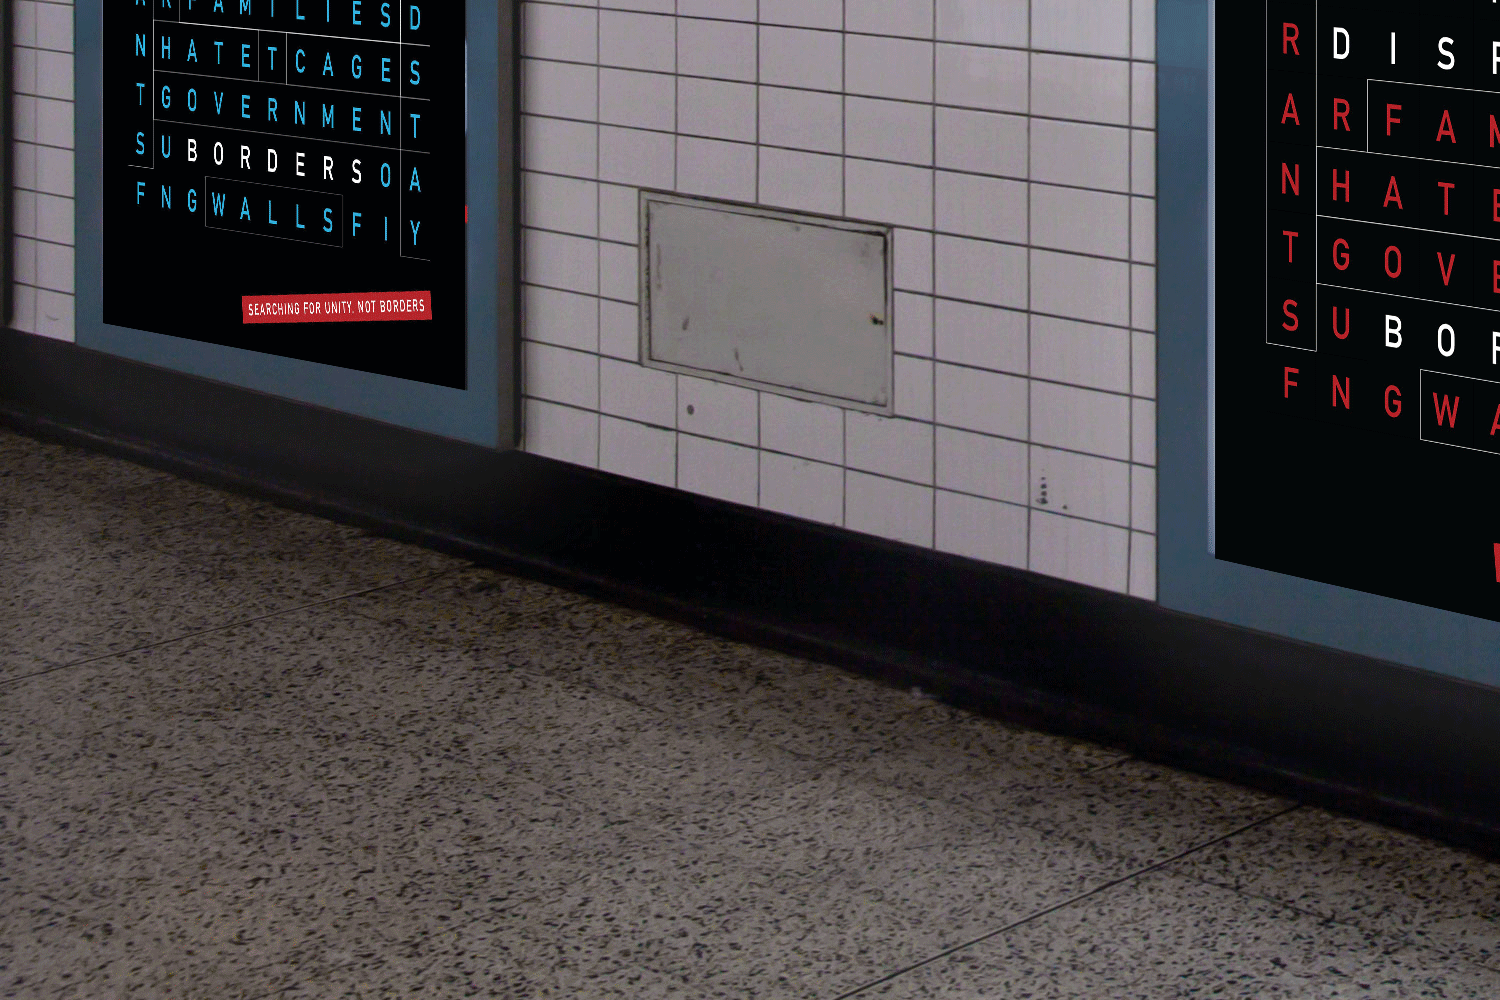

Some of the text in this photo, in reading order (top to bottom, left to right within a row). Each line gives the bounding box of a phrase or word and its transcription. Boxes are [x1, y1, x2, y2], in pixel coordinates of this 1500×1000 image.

[248, 302, 300, 317] SEARCHING
[303, 301, 321, 315] FOR
[357, 299, 376, 314] NOT
[379, 298, 425, 313] BORDERS
